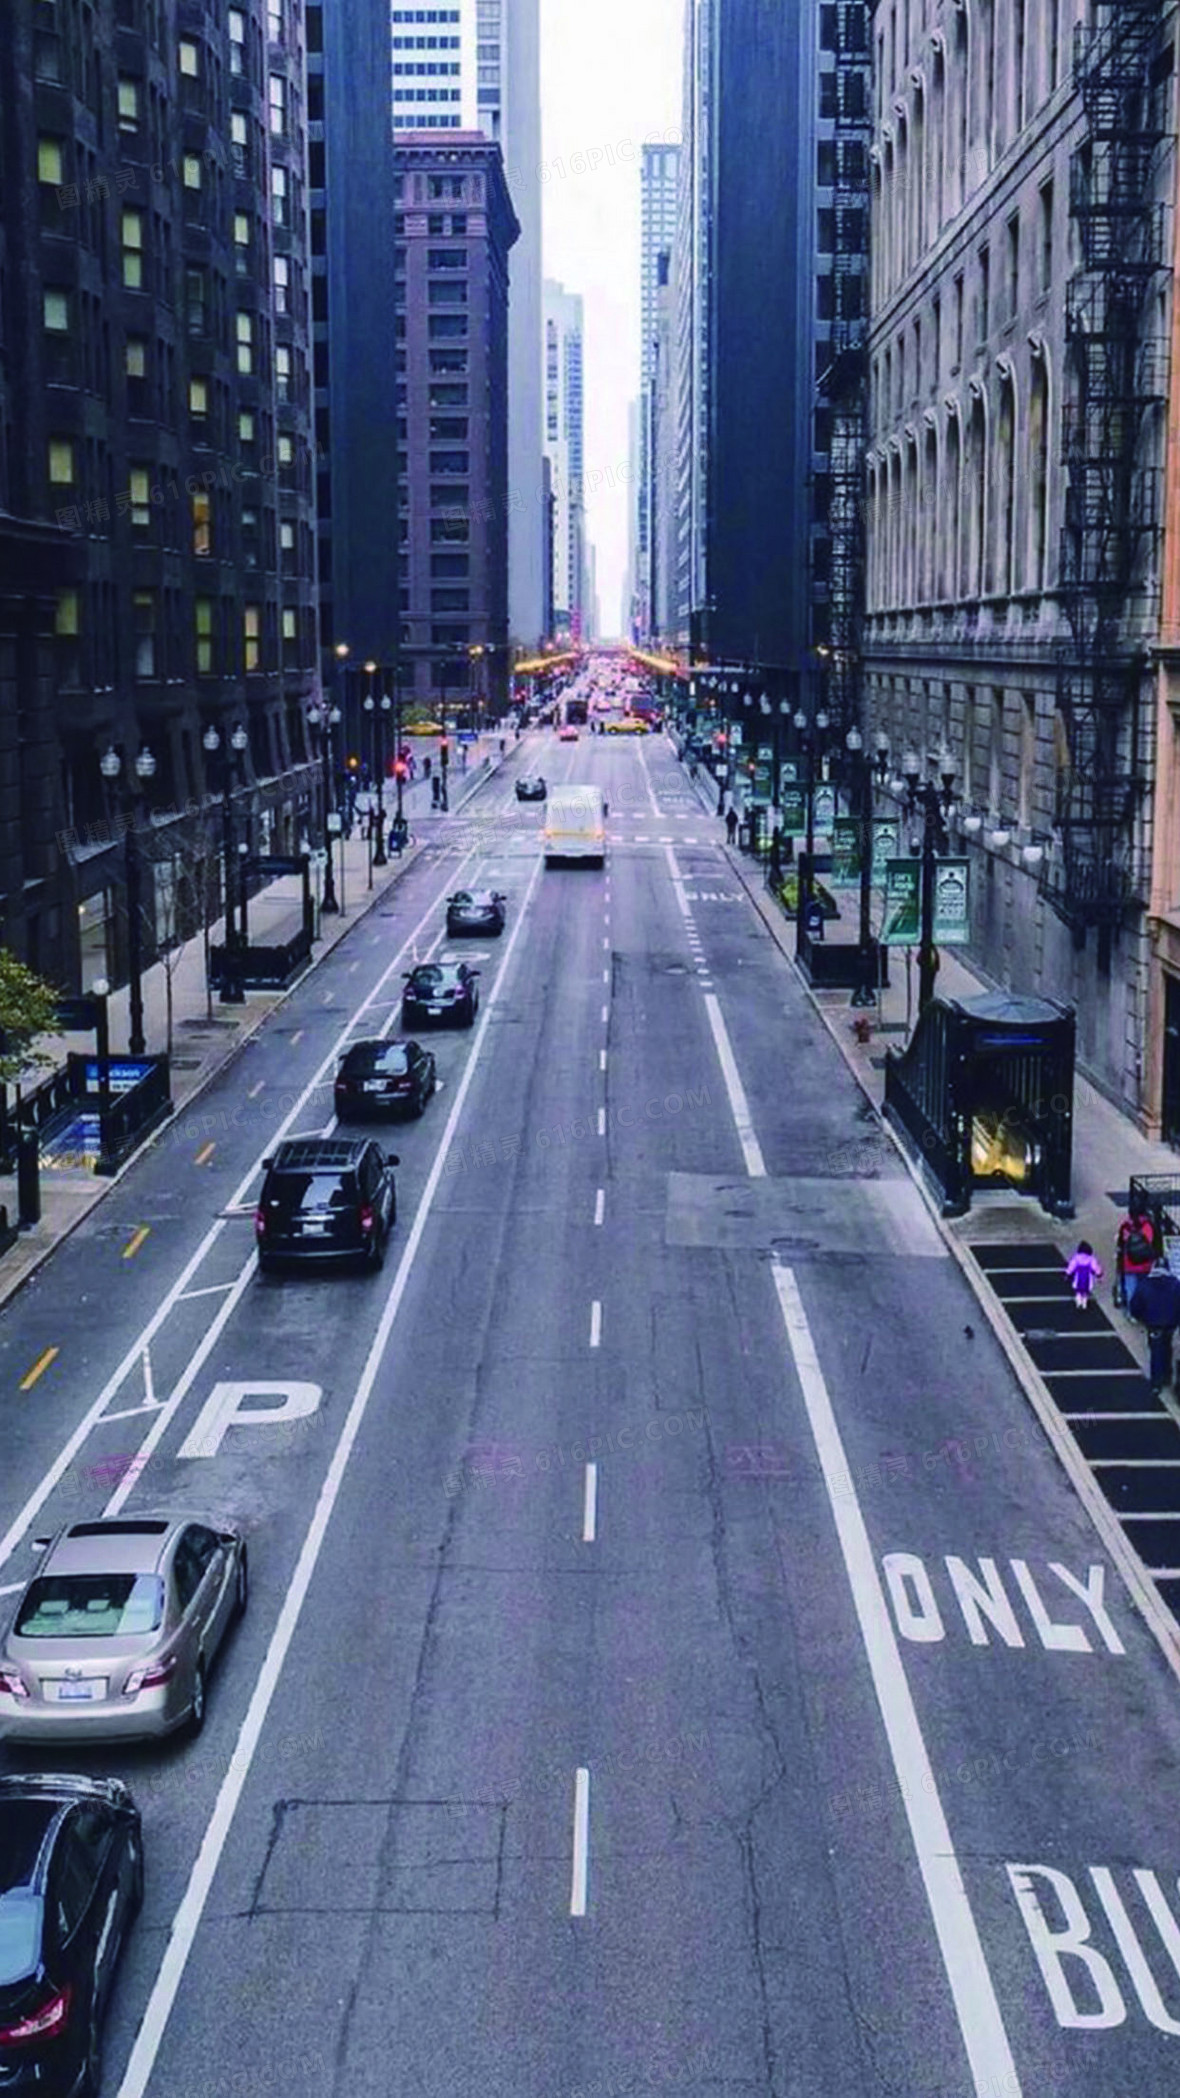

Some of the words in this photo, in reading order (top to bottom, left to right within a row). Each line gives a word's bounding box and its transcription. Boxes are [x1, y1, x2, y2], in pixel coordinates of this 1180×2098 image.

[176, 1381, 323, 1458] P
[882, 1553, 1126, 1654] ONLY
[1005, 1863, 1180, 2037] BU
